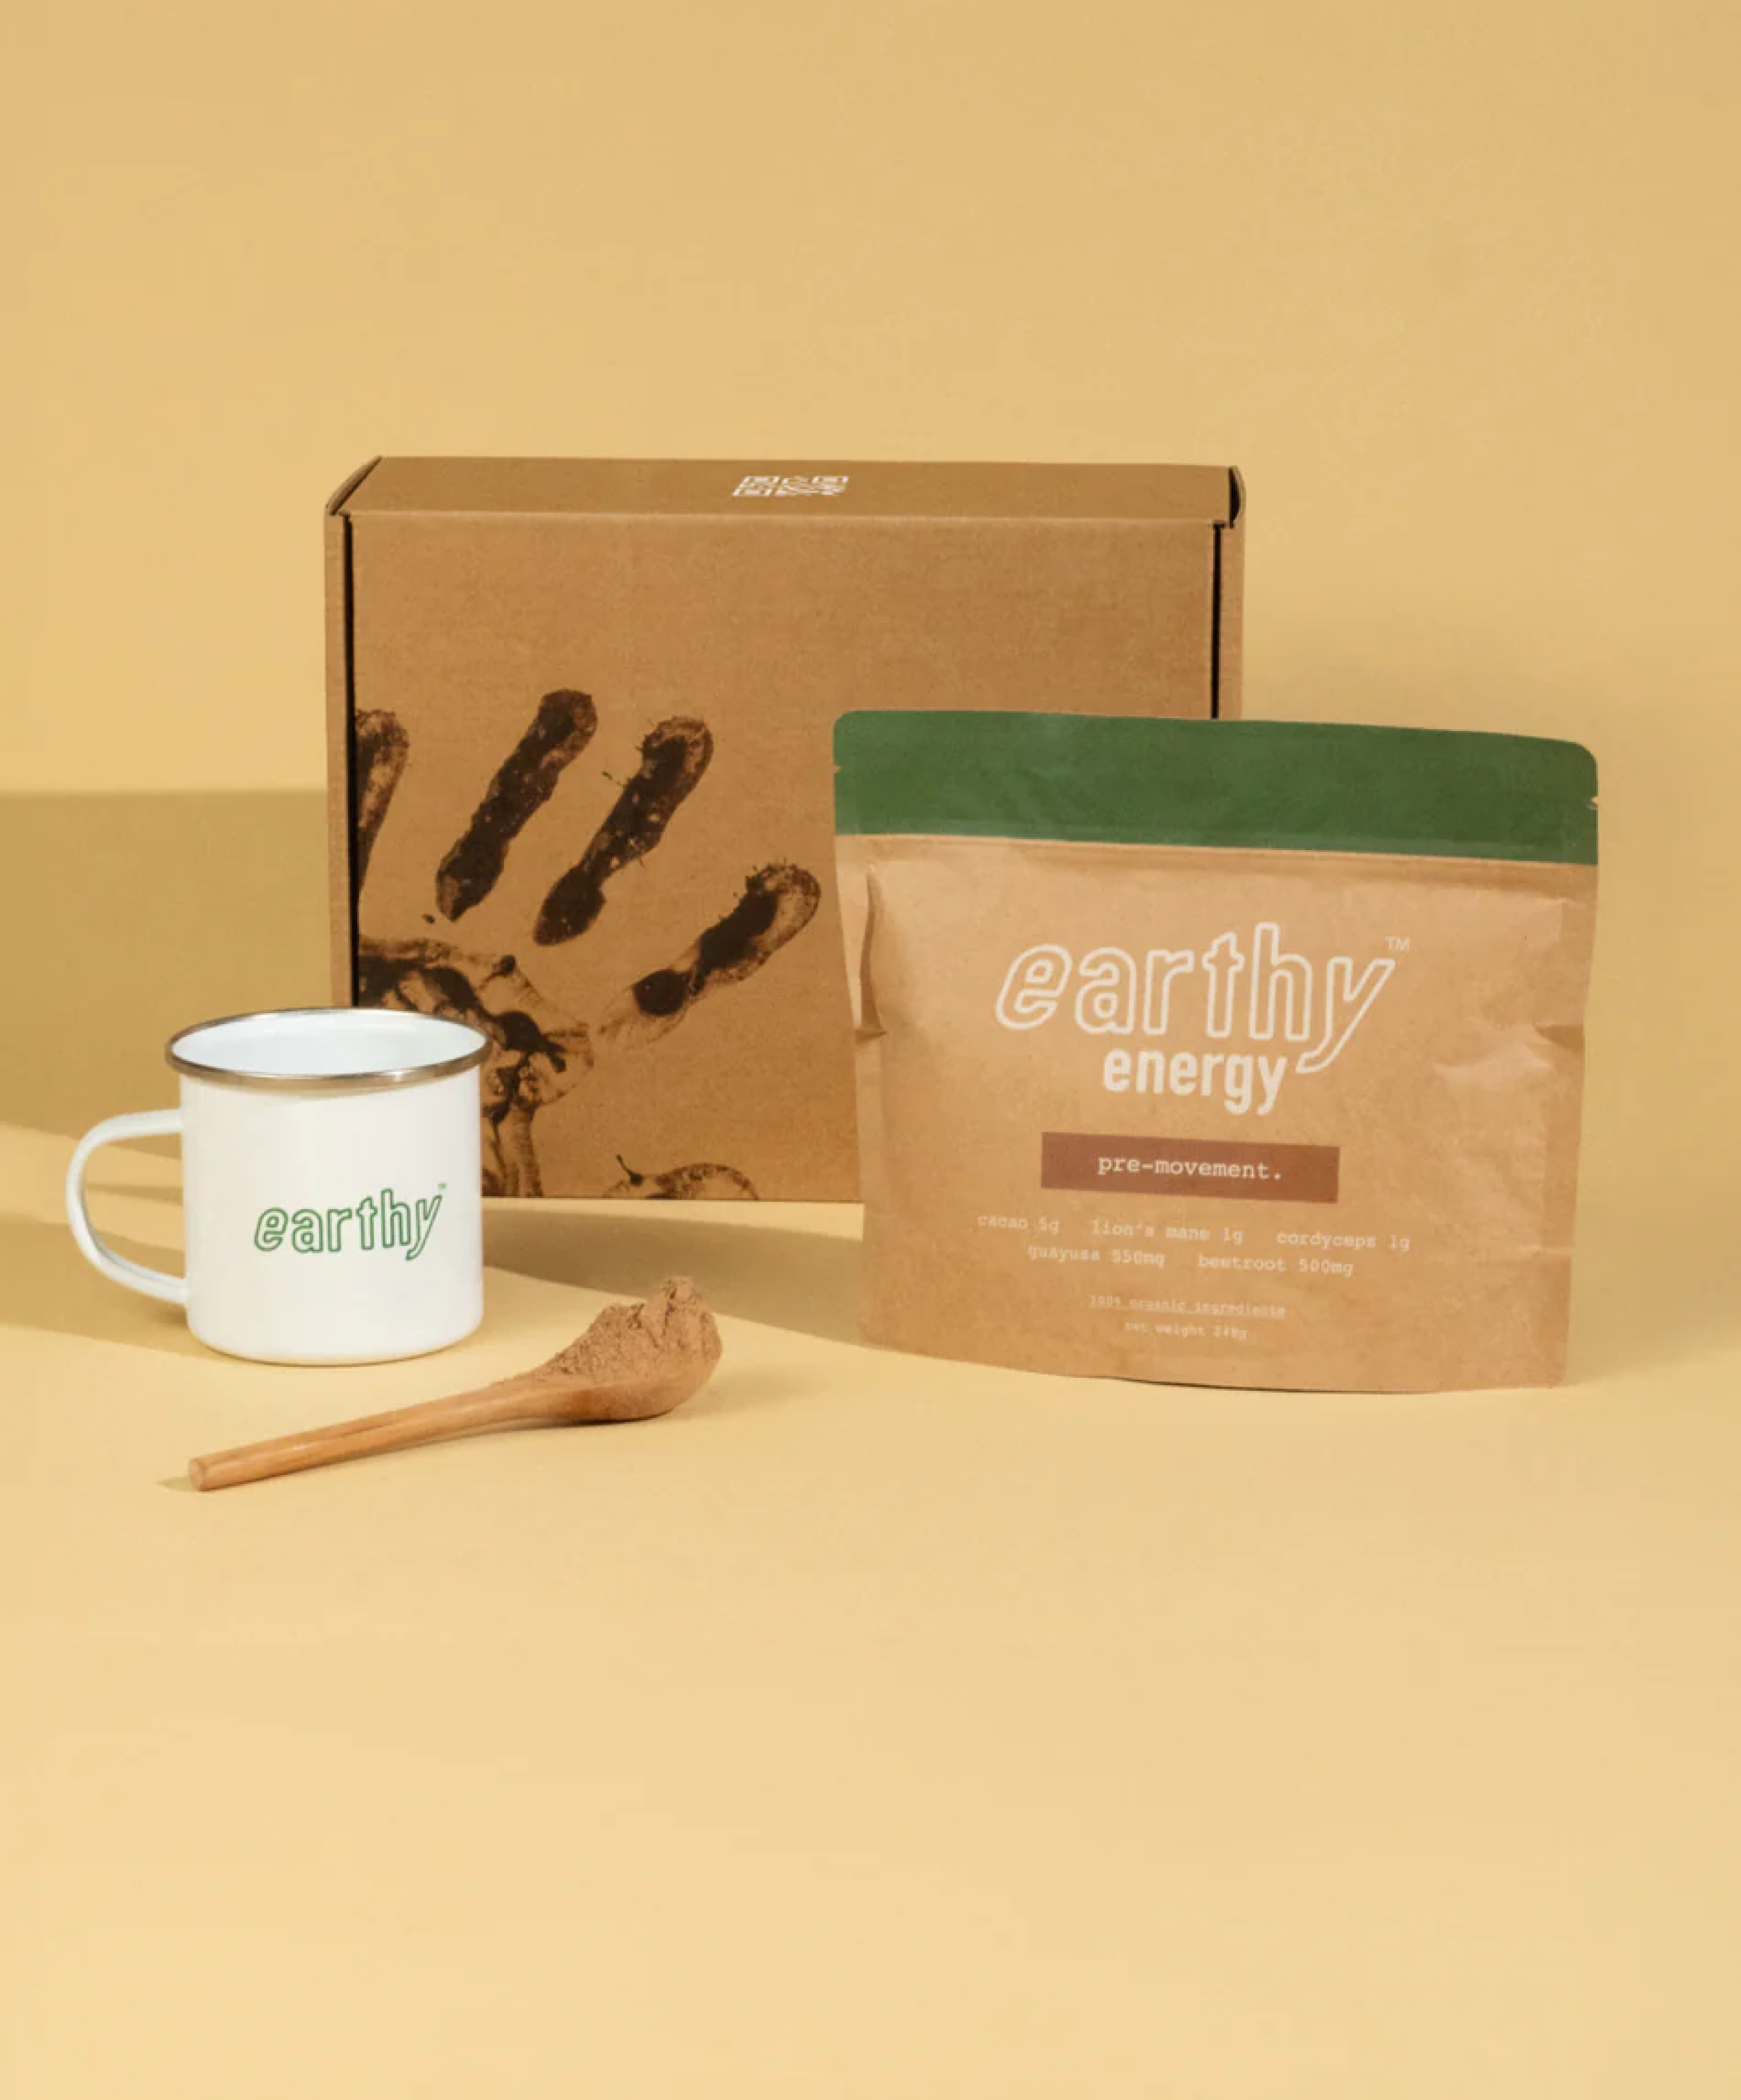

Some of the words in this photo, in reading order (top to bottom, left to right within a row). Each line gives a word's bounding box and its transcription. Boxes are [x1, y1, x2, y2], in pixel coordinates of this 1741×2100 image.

[996, 923, 1396, 1073] earthy
[1385, 936, 1410, 951] TM
[1104, 1049, 1287, 1115] energy
[1097, 1157, 1281, 1180] pre-movement.
[254, 1187, 442, 1261] earthy
[978, 1215, 1028, 1228] cacao
[1039, 1216, 1060, 1235] 5g
[1092, 1219, 1155, 1237] lion's
[1165, 1225, 1210, 1241] mane
[1223, 1226, 1244, 1244] 1g
[1276, 1230, 1377, 1250] cordyceps
[1390, 1234, 1411, 1251] 1g
[1028, 1244, 1100, 1263] guayusa
[1111, 1249, 1166, 1268] 550mg
[1198, 1252, 1287, 1271] beetroot
[1298, 1257, 1353, 1277] 500mg
